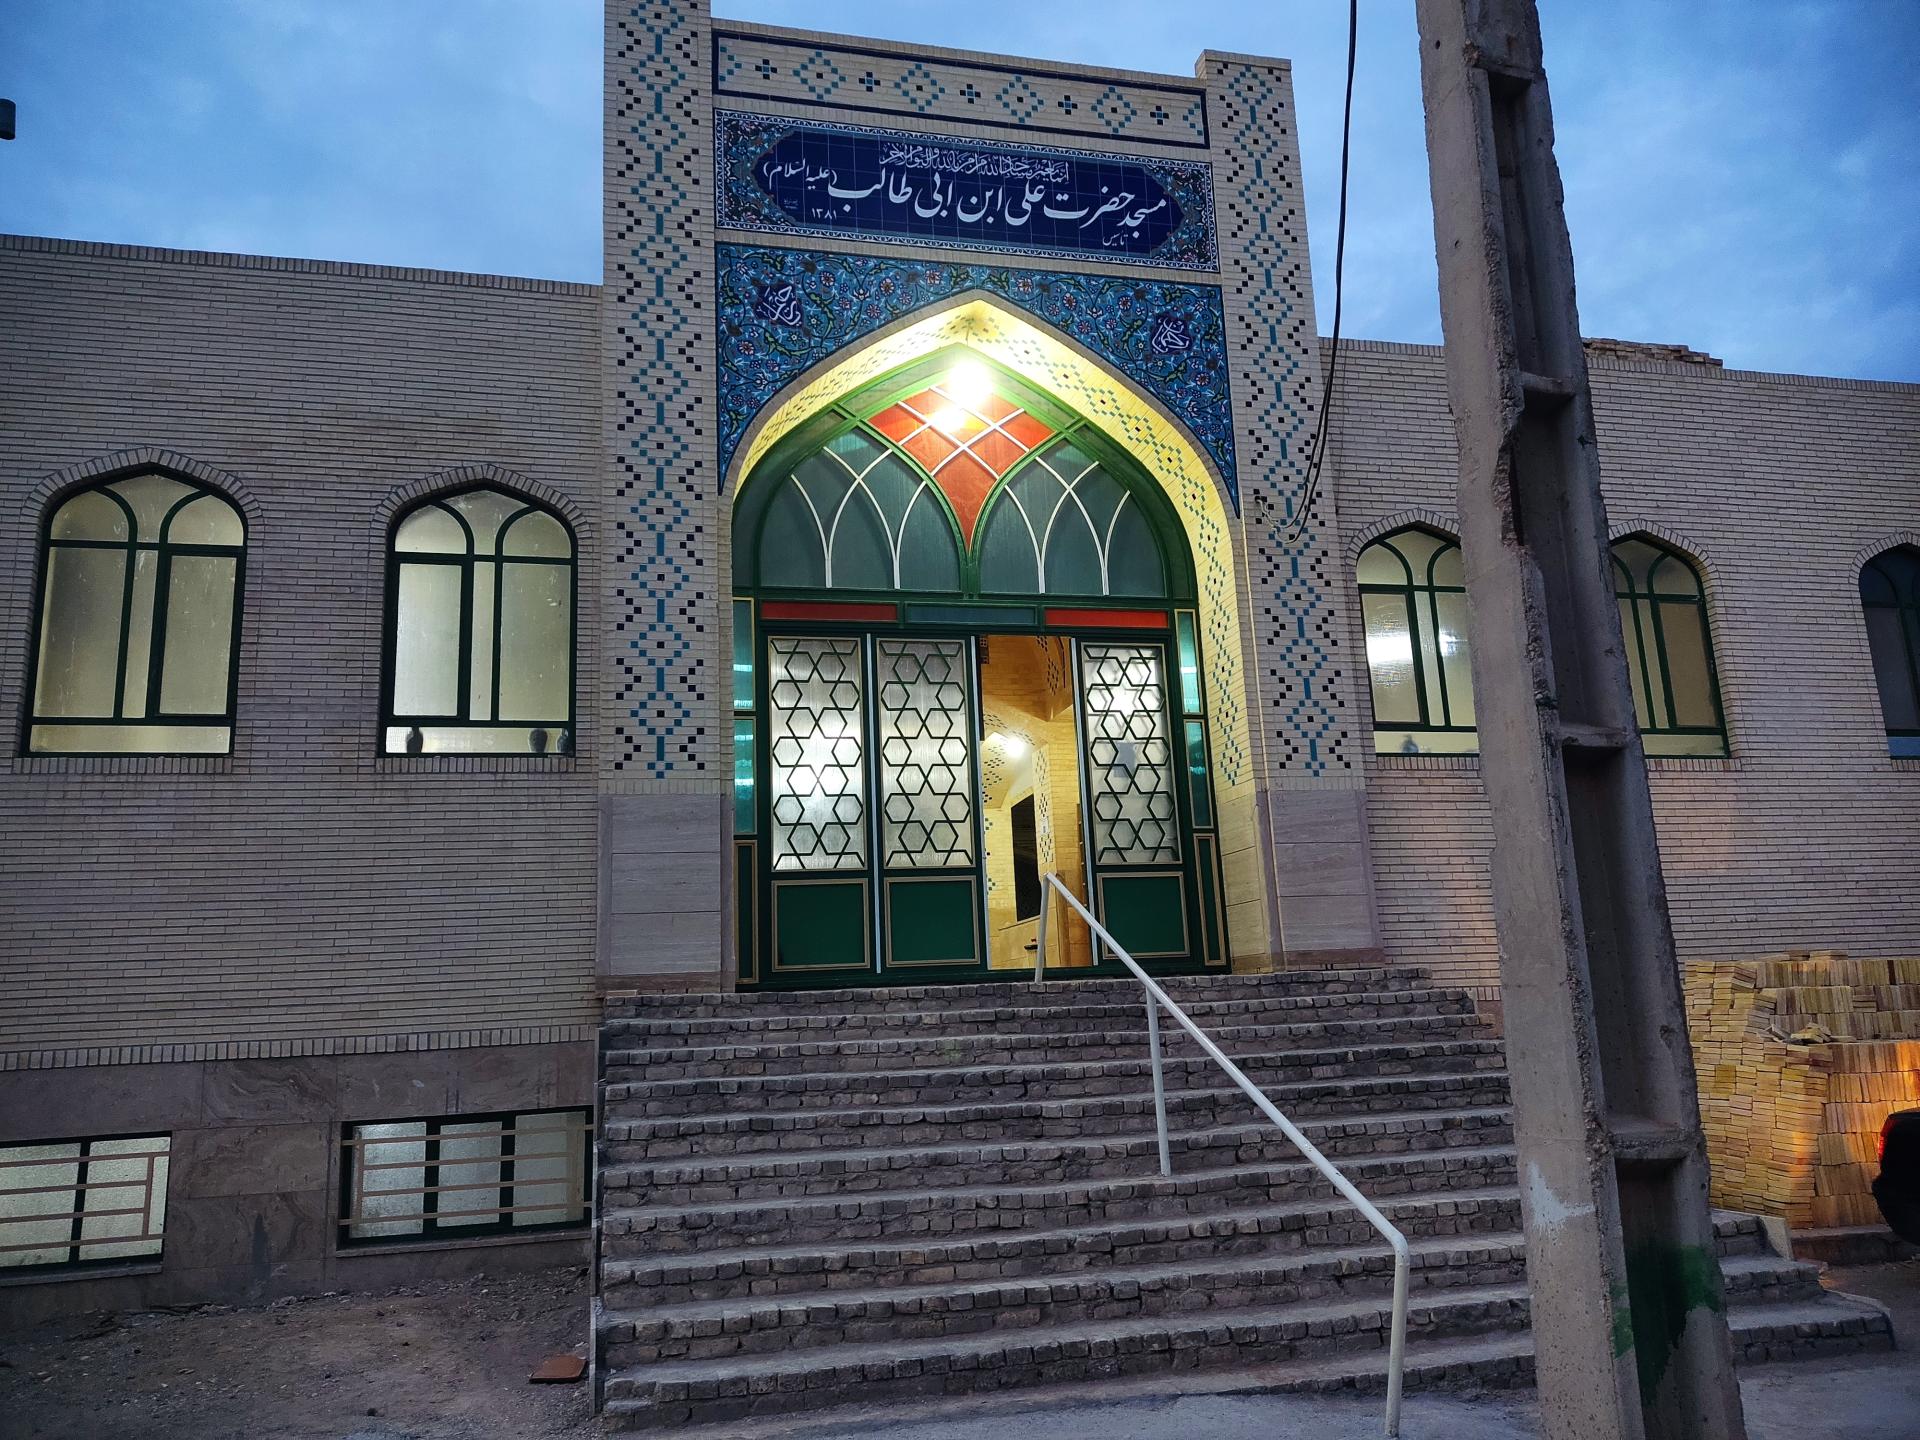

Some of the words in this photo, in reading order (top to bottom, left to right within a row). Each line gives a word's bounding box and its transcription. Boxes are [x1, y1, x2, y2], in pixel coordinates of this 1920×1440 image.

[828, 167, 913, 213] طالب
[914, 172, 954, 218] ابی
[957, 186, 1004, 225] ابن
[1005, 180, 1046, 227] علی
[1043, 186, 1136, 229] حضرت
[1117, 199, 1167, 240] مسجد
